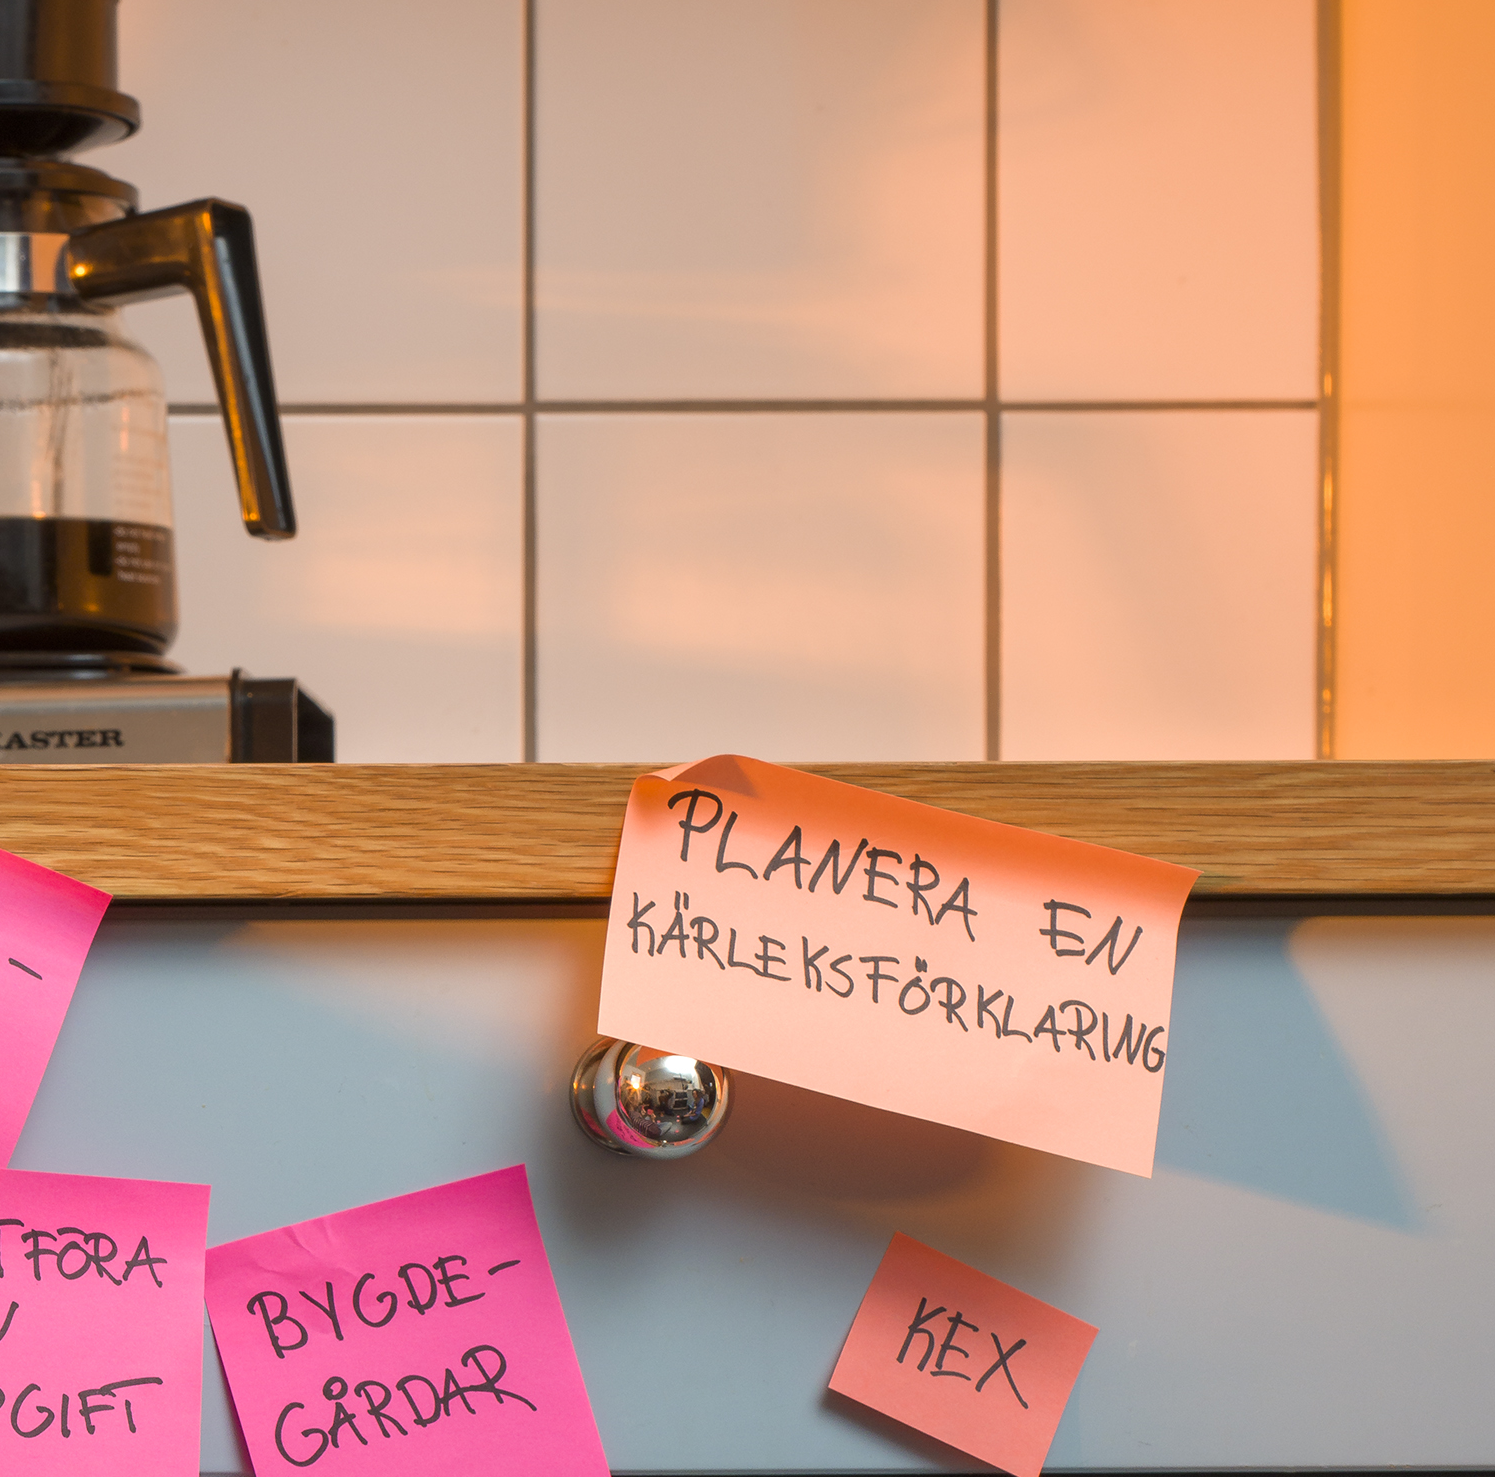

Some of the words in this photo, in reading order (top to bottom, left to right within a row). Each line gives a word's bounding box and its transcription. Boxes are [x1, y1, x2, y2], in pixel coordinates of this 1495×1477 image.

[668, 788, 978, 942] PLANERA
[1039, 899, 1143, 975] EN
[627, 891, 1165, 1073] KÄRLEKSFÖRKLARING
[275, 1345, 537, 1467] GÅRDAR
[896, 1297, 1029, 1409] KEX
